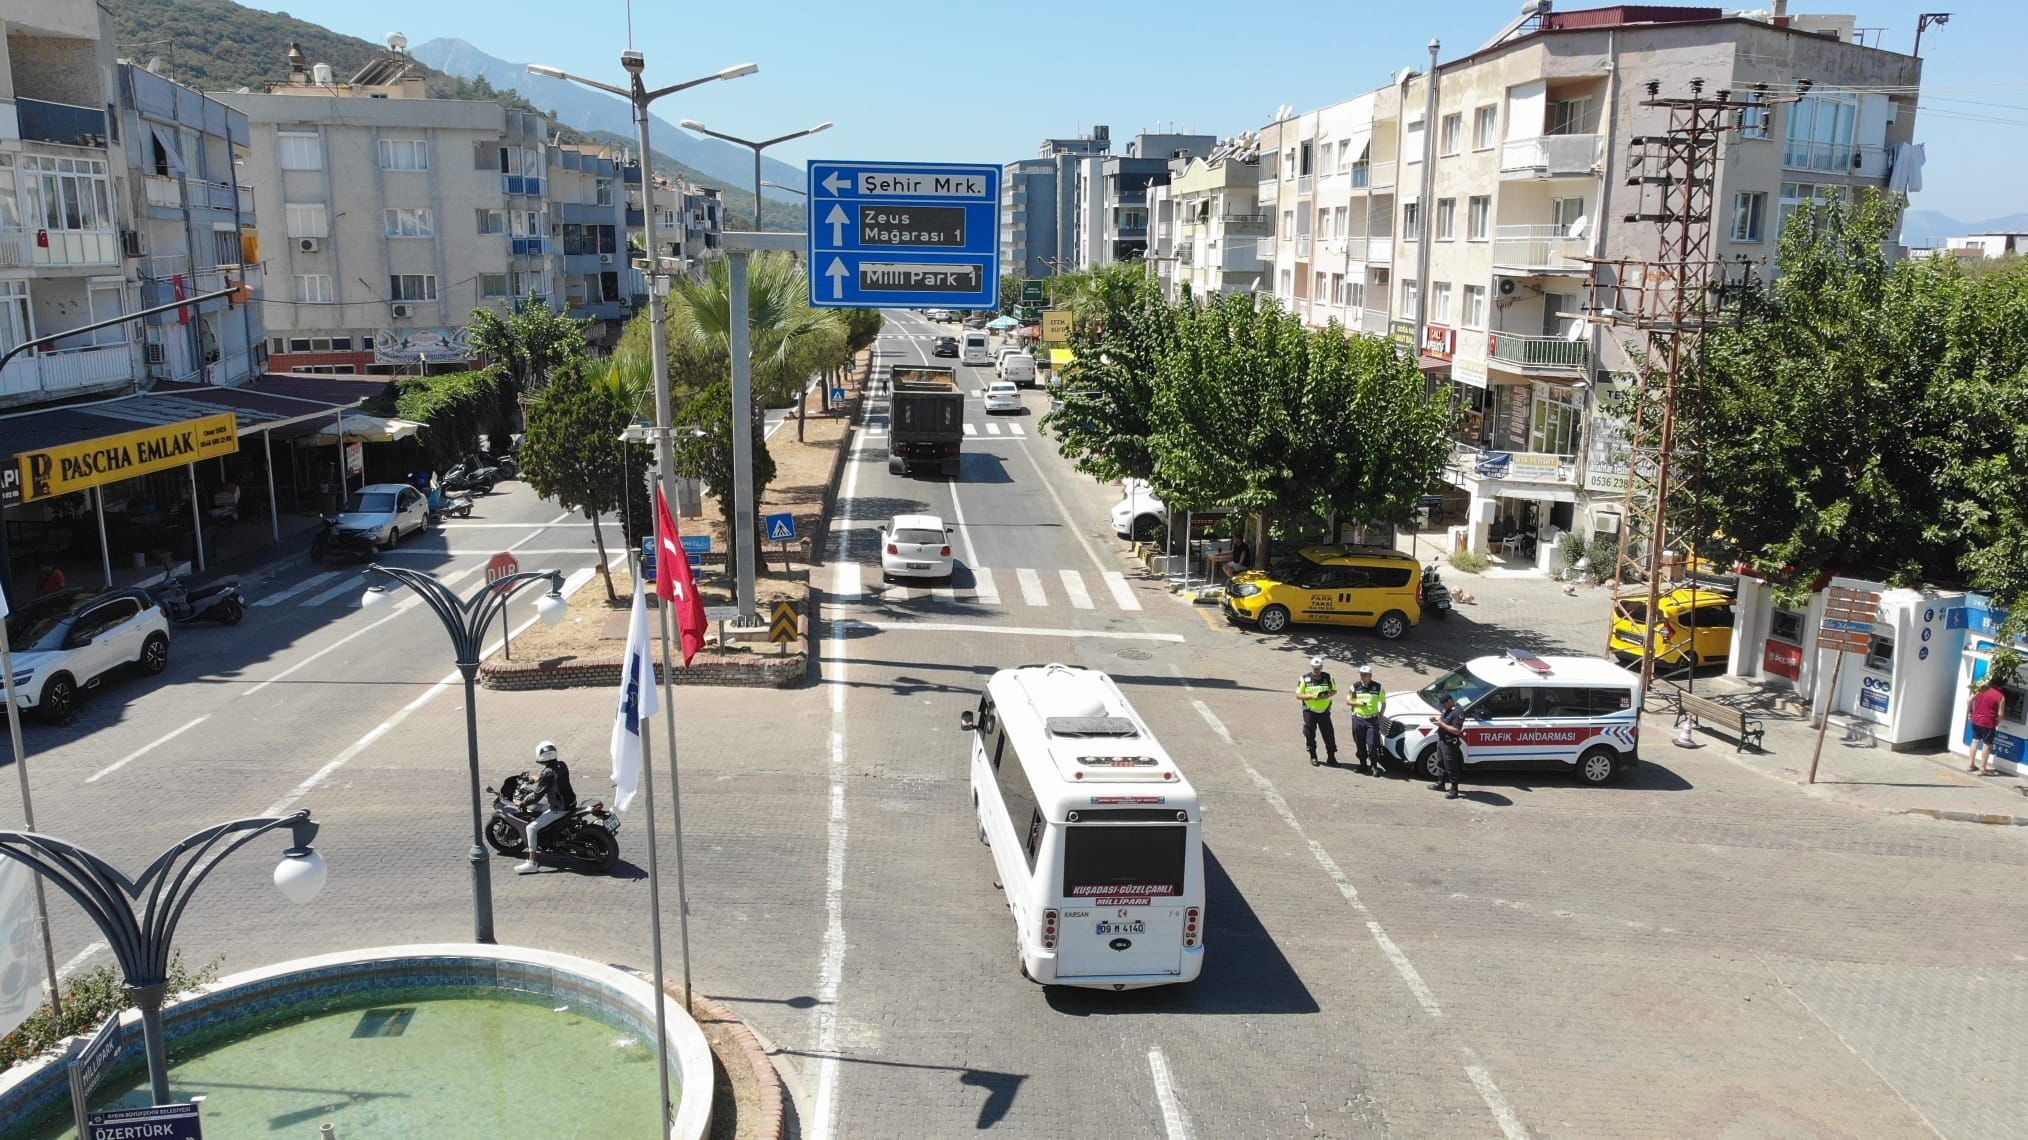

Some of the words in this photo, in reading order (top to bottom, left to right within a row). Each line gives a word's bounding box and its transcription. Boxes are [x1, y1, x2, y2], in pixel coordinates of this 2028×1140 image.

[864, 175, 922, 194] Şehir
[934, 178, 982, 194] Mrk.
[865, 210, 910, 225] Zeus
[864, 228, 944, 244] Mağarası
[954, 229, 962, 243] 1
[866, 269, 904, 285] Milli
[911, 271, 958, 286] Park
[968, 271, 977, 287] 1
[62, 445, 135, 482] PASCHA
[136, 431, 195, 464] EMLAK
[1592, 475, 1612, 487] 0536
[487, 563, 517, 585] DUR
[1480, 733, 1512, 742] TRAFİK
[1517, 733, 1577, 742] JANDARMASI
[1102, 925, 1111, 933] 09
[1114, 925, 1120, 933] M
[1122, 925, 1144, 933] 4140
[83, 1041, 114, 1086] MİLLİPARK
[125, 1109, 160, 1118] BÜYÜKŞEHİR
[160, 1107, 191, 1115] BELEDİYESİ
[95, 1122, 174, 1140] ÖZERTÜRK
